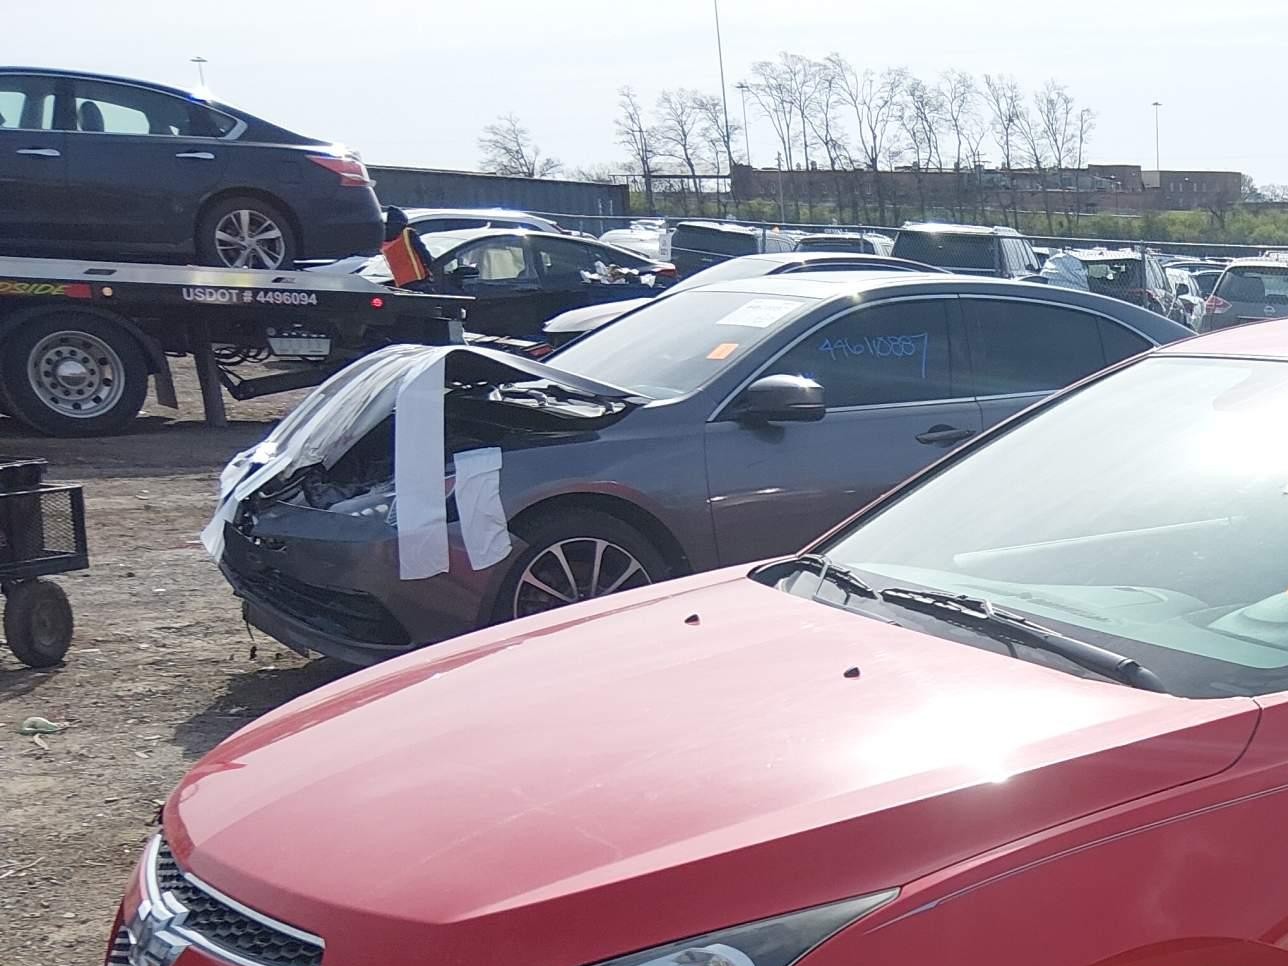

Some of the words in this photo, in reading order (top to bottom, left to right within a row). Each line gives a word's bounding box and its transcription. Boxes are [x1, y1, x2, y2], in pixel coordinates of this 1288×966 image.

[182, 287, 239, 302] USDOT
[243, 290, 253, 303] #
[256, 291, 318, 305] 4496094
